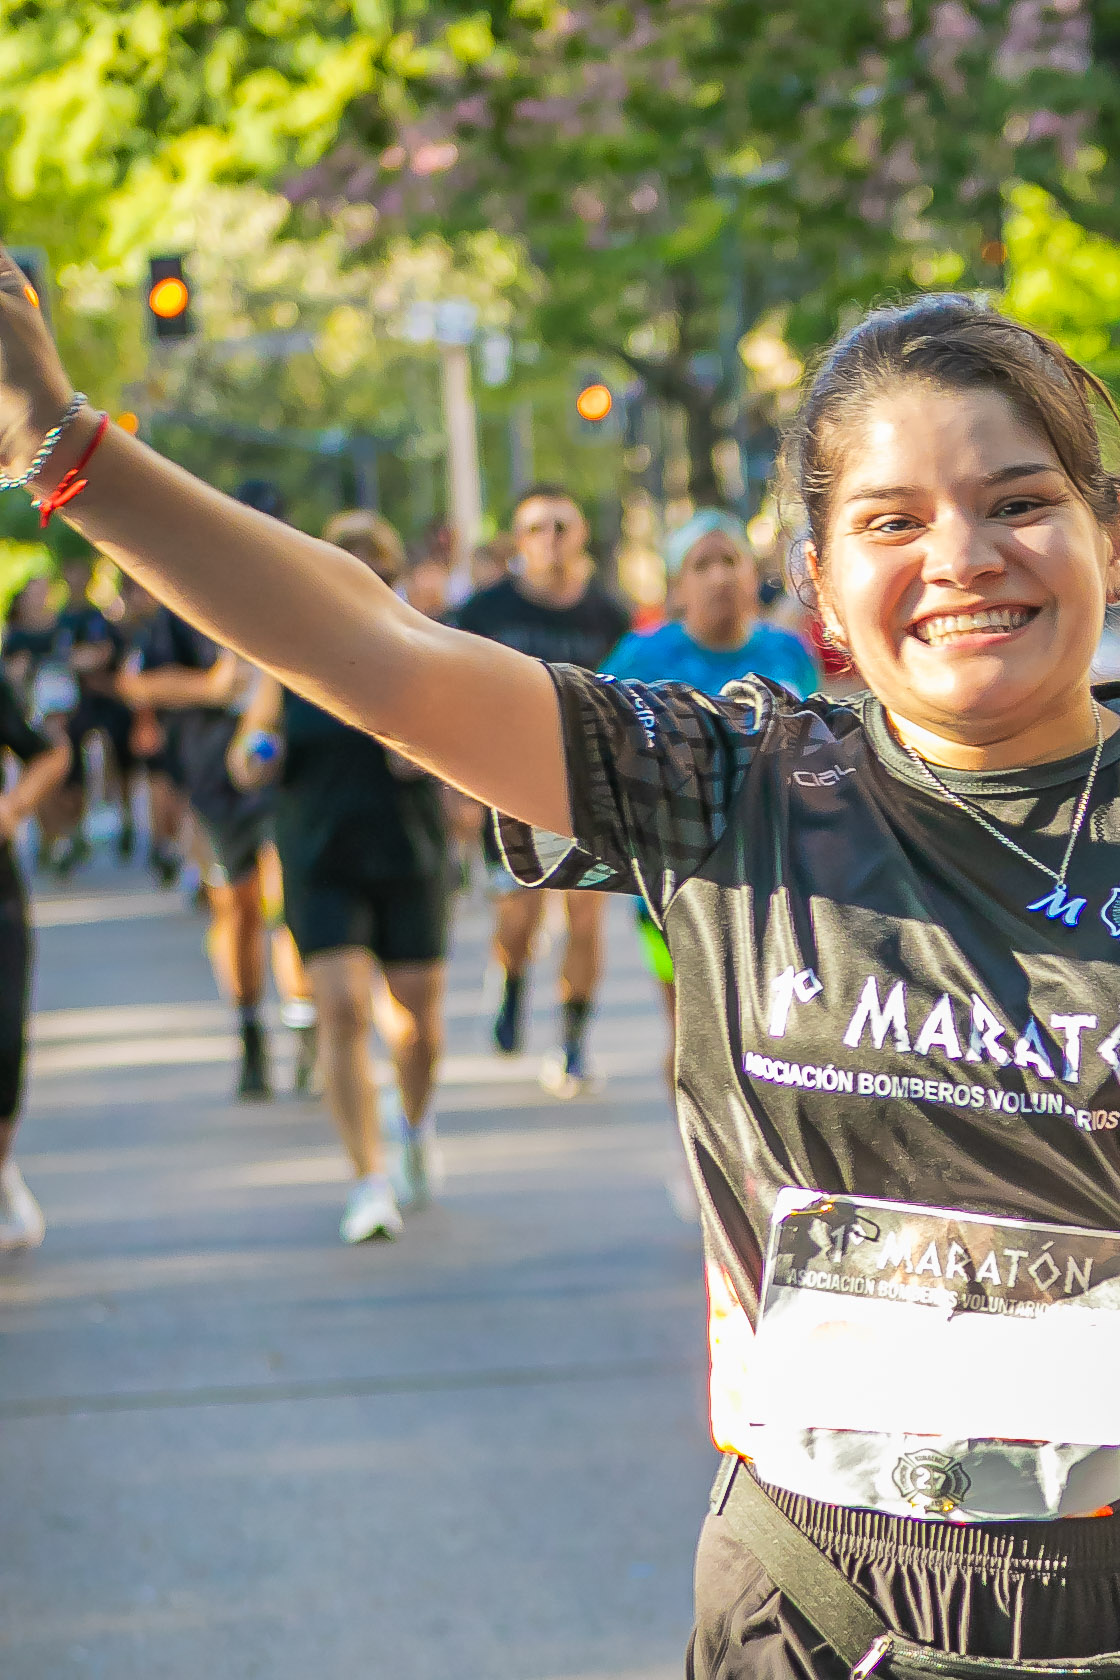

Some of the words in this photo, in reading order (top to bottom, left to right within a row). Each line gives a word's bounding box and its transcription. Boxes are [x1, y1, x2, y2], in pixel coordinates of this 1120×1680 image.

[857, 1071, 986, 1109] BOMBEROS
[876, 1230, 1094, 1294] MARATÓN
[915, 1465, 947, 1491] 27
